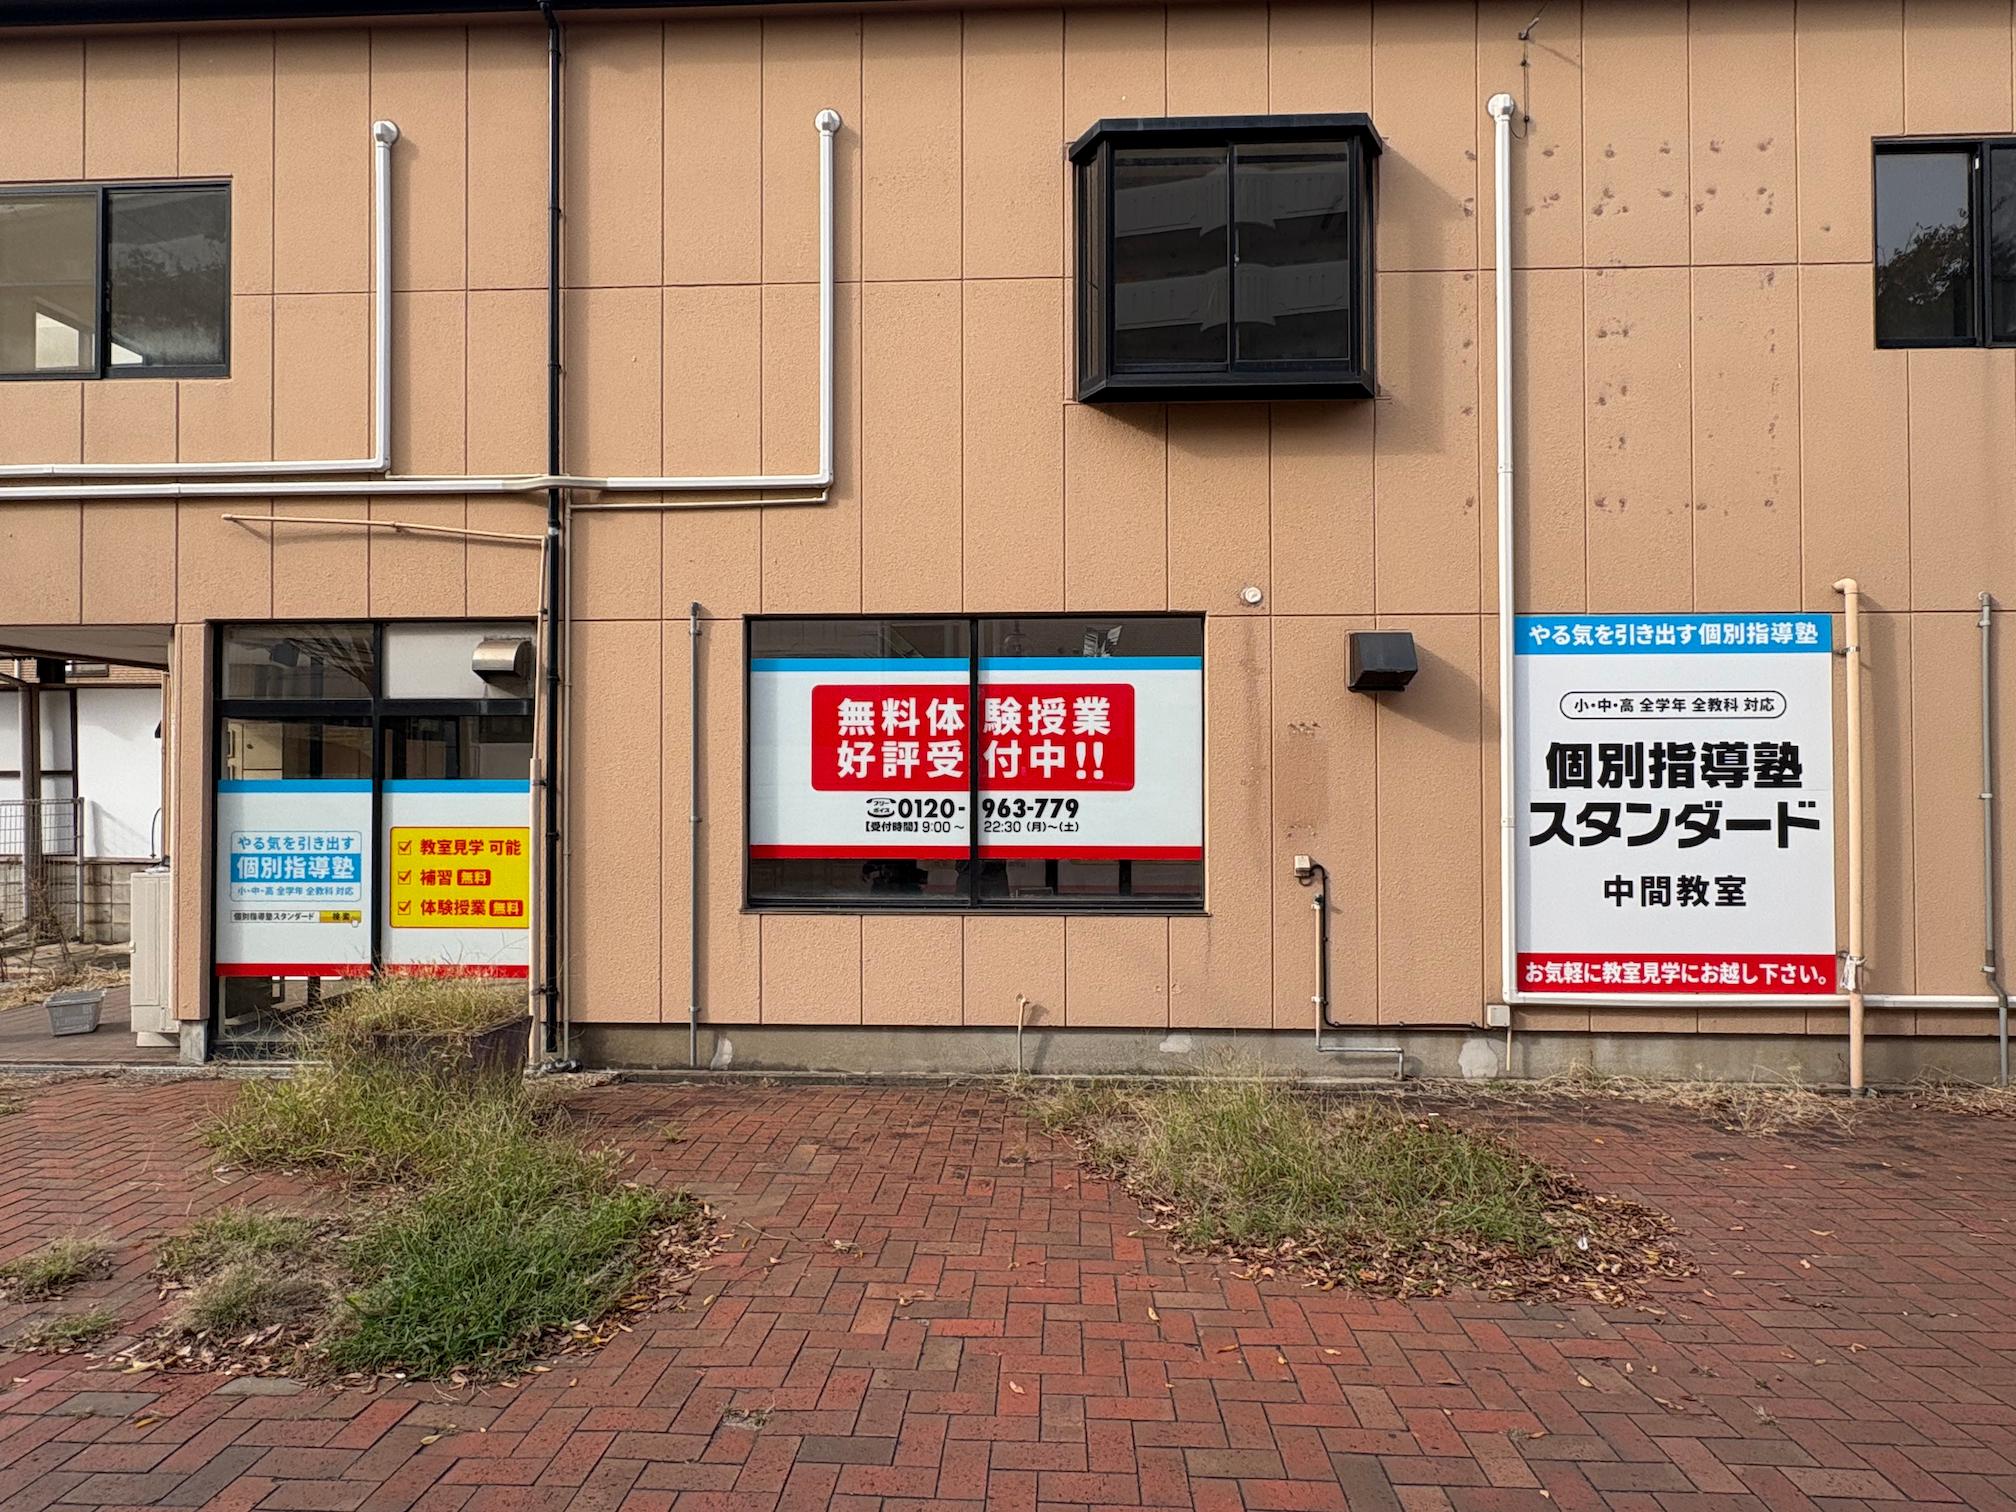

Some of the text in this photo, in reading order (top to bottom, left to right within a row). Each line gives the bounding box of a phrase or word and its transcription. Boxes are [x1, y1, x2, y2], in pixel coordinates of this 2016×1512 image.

[1529, 622, 1818, 646] やる気を引き出す個別指導塾
[1639, 697, 1687, 713] 全学年
[1691, 697, 1738, 713] 全教科
[1744, 697, 1775, 712] 対応
[1546, 742, 1803, 789] 個別指導塾
[1529, 801, 1820, 849] スタンダード
[237, 836, 354, 851] やる気を引き出す
[420, 839, 521, 856] 教室見学 可能
[237, 856, 355, 880] 個別指導塾
[420, 868, 488, 886] 補習 無料
[276, 887, 303, 896] 全学年
[306, 887, 334, 896] 全教科
[336, 887, 354, 896] 対応
[1603, 875, 1747, 907] 中間教室
[234, 912, 315, 921] 個別指導塾スタンダード
[421, 900, 520, 916] 体験授業 無料
[1525, 962, 1828, 985] お気軽に教室見学にお越し下さい。
